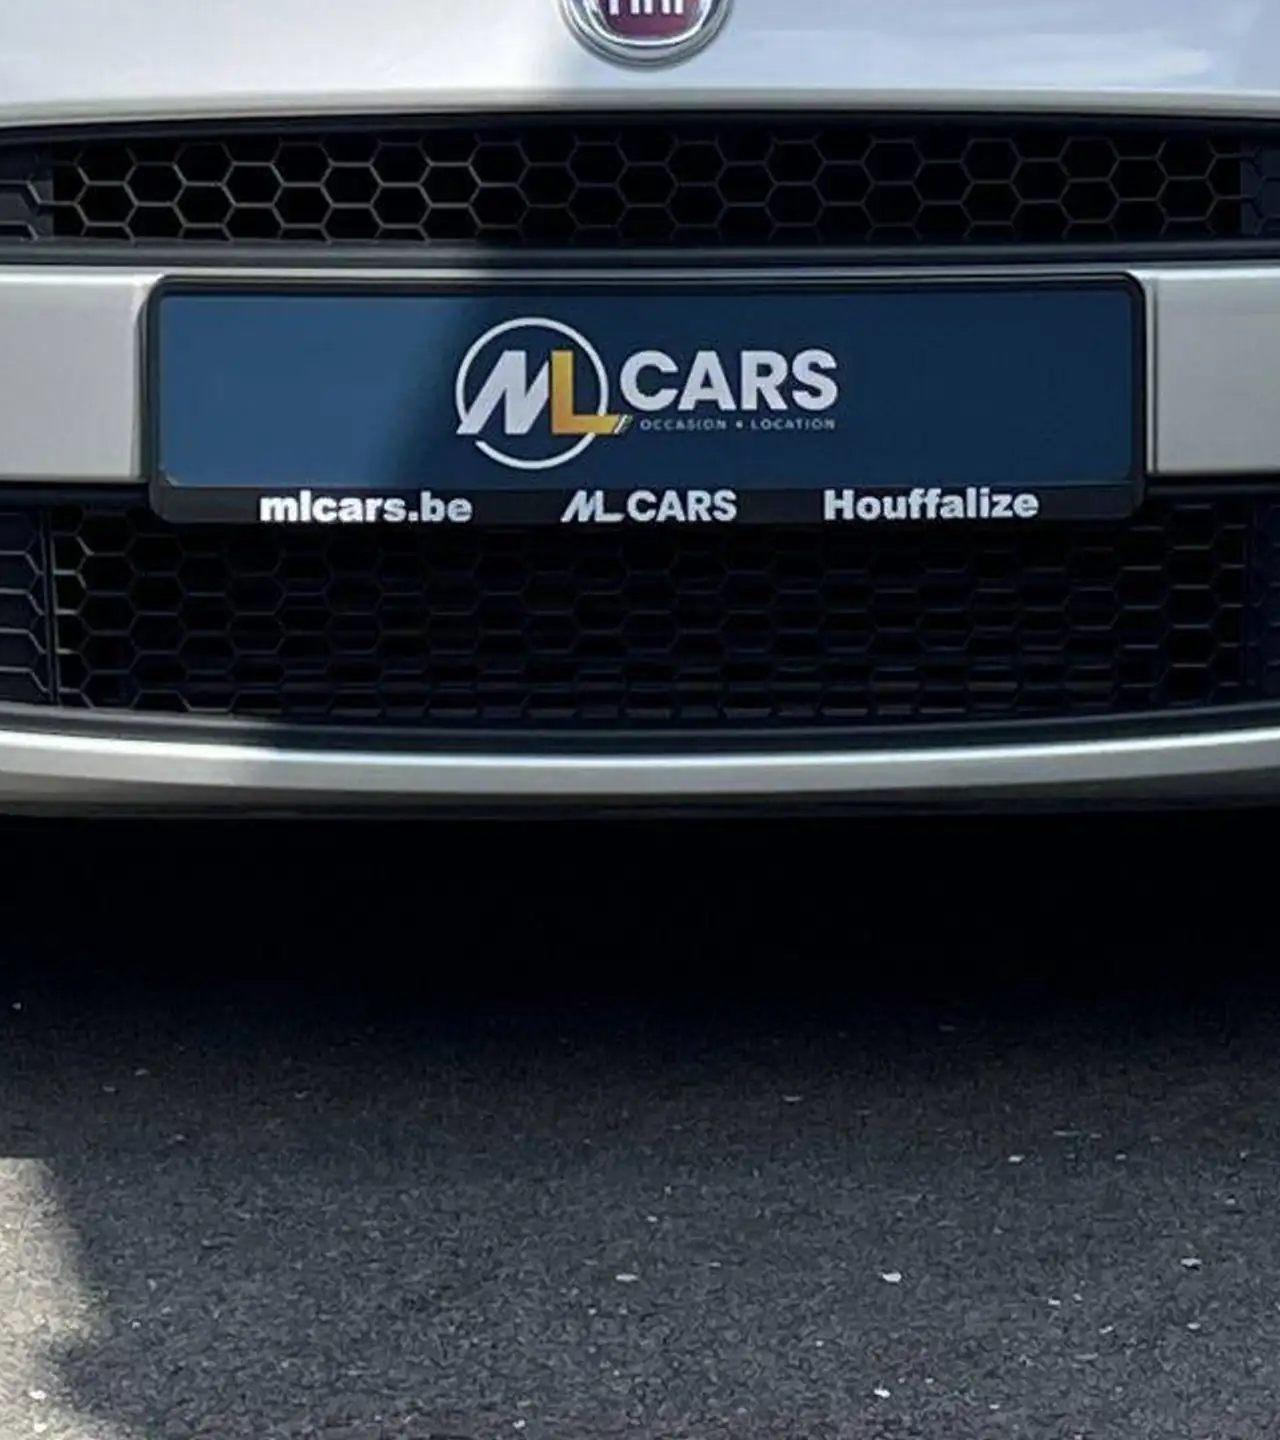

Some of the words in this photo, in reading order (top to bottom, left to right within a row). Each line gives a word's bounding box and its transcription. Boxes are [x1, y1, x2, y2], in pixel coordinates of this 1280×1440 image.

[456, 349, 620, 436] ML
[620, 349, 839, 411] CARS
[639, 417, 727, 432] OCCASION
[750, 416, 836, 431] LOCATION
[259, 490, 474, 523] mlcars.be
[626, 489, 738, 523] CARS
[823, 486, 1040, 521] Houffalize
